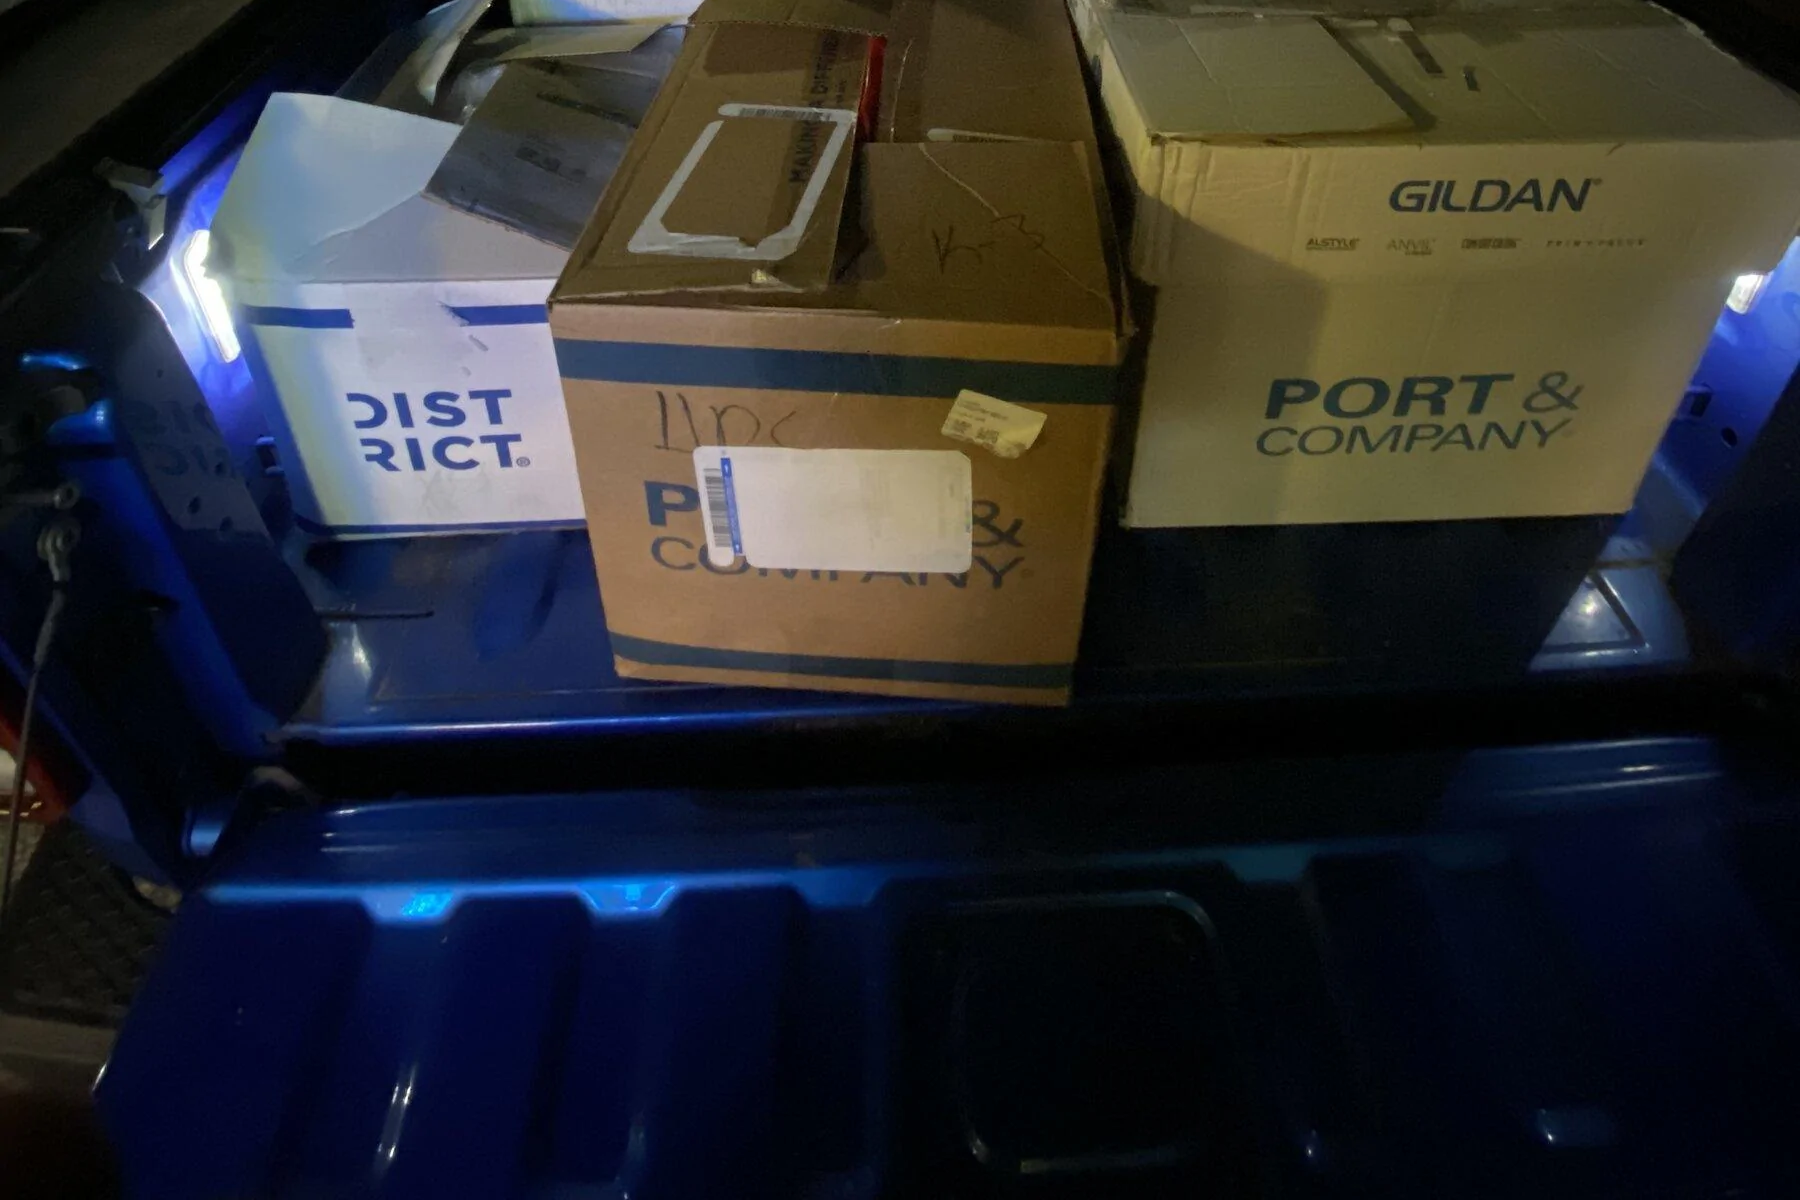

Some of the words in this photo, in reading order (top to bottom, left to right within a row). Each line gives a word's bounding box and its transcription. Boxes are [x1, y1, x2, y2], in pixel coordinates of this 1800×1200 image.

[1389, 178, 1593, 213] GILDAN
[1306, 238, 1357, 249] ALSTYLE
[346, 389, 512, 429] DIST
[1265, 374, 1515, 419] PORT
[1522, 370, 1584, 413] &
[1256, 417, 1573, 457] COMPANY
